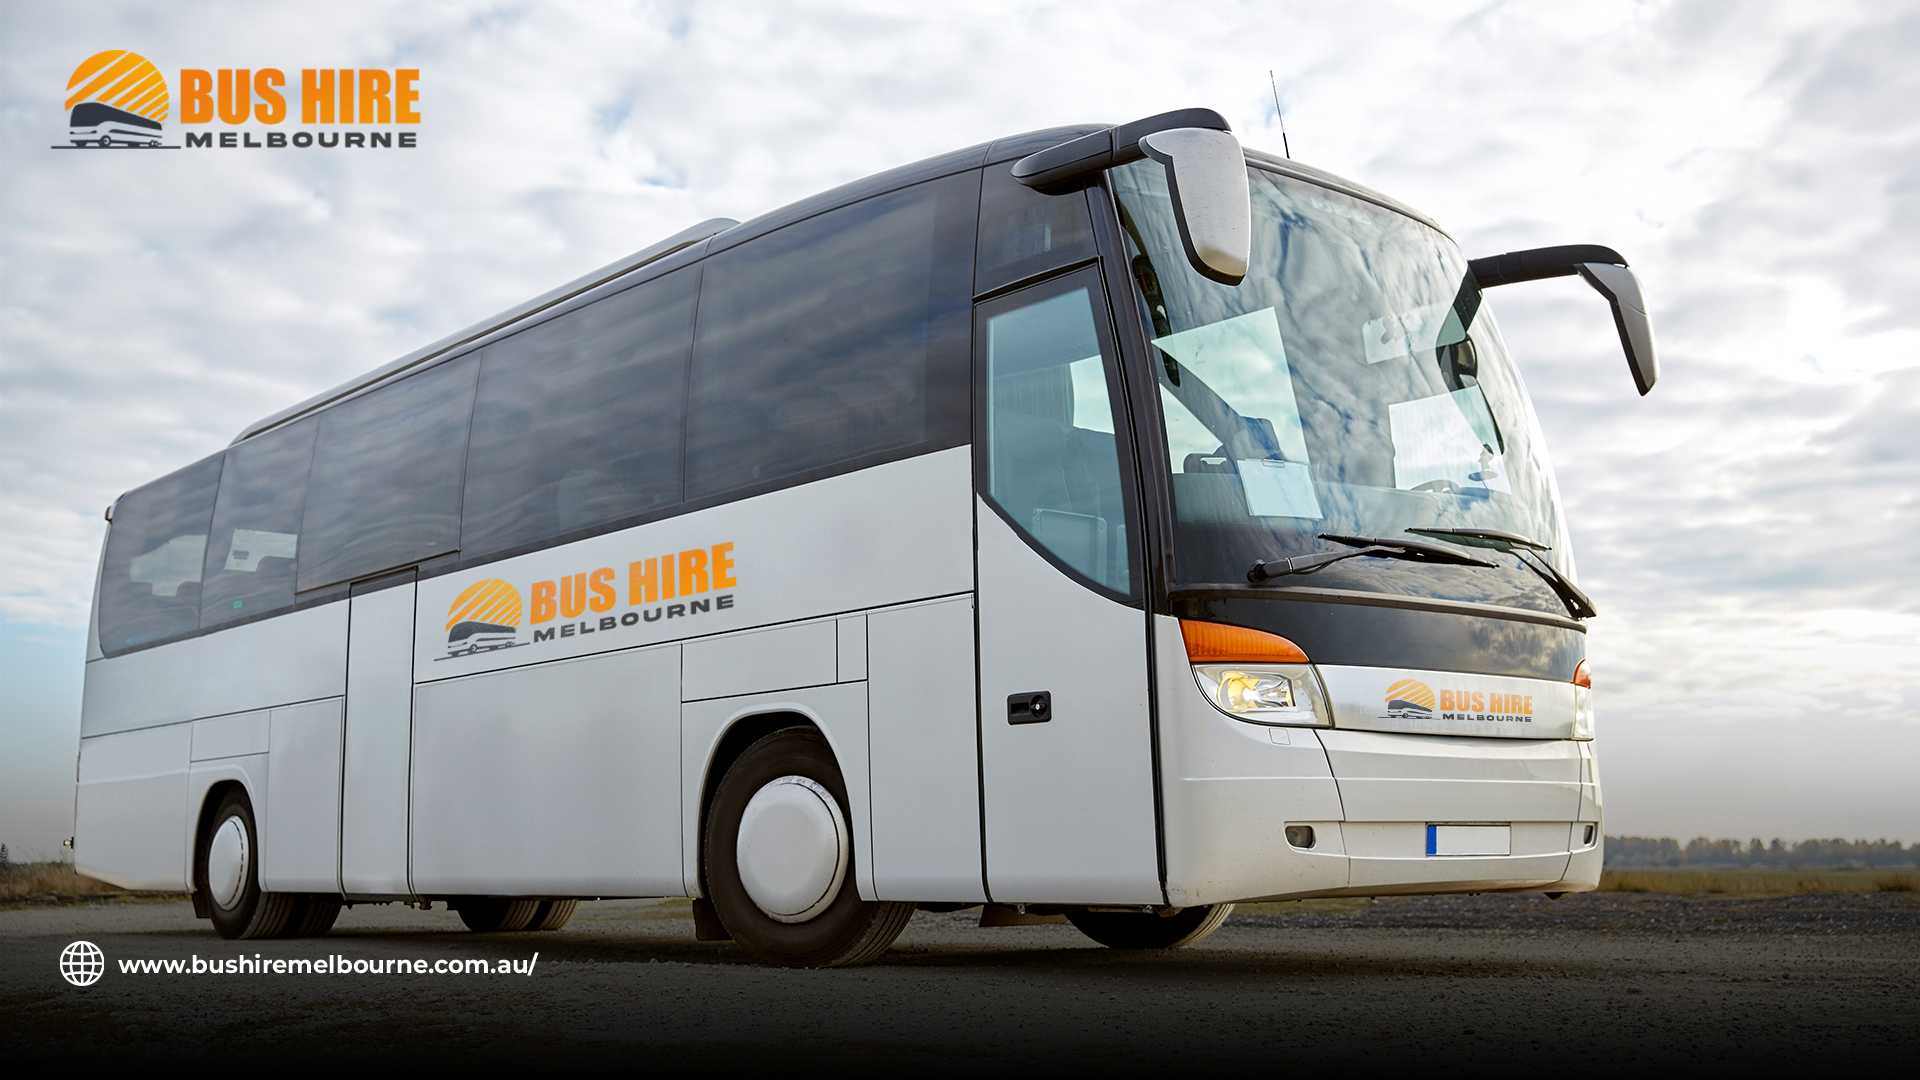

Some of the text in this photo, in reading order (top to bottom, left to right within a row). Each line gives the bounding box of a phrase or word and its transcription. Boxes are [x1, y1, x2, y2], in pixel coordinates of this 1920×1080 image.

[531, 542, 737, 625] BUS HIRE
[533, 594, 734, 643] MELBOURNE
[1440, 689, 1533, 714] BUS HIRE
[1442, 713, 1532, 722] MELBOURNE
